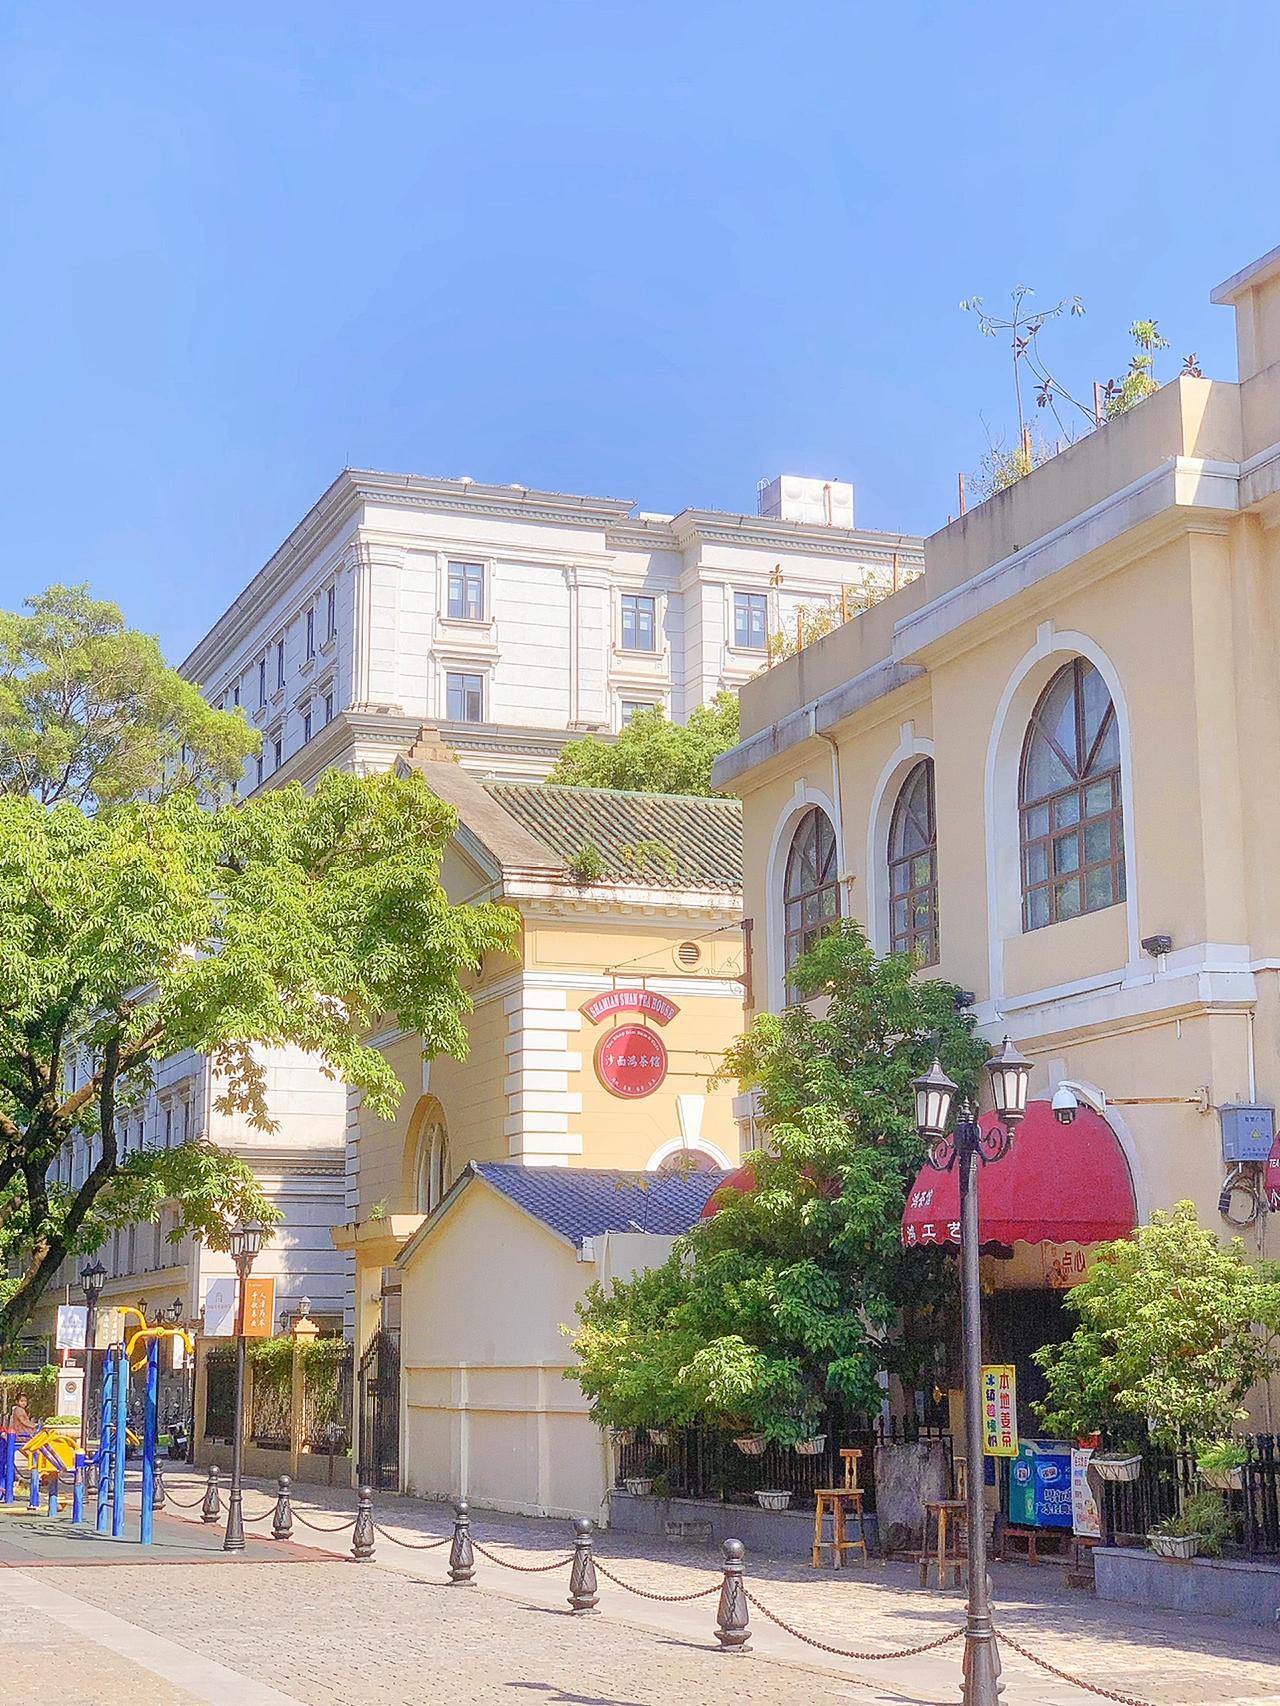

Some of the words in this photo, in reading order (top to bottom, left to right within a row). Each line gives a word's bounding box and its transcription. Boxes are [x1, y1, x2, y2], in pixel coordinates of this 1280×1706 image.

[588, 993, 620, 1018] SHAMIAN
[619, 992, 638, 1005] SWAN
[638, 994, 651, 1007] TEA
[651, 997, 675, 1020] HOUSE
